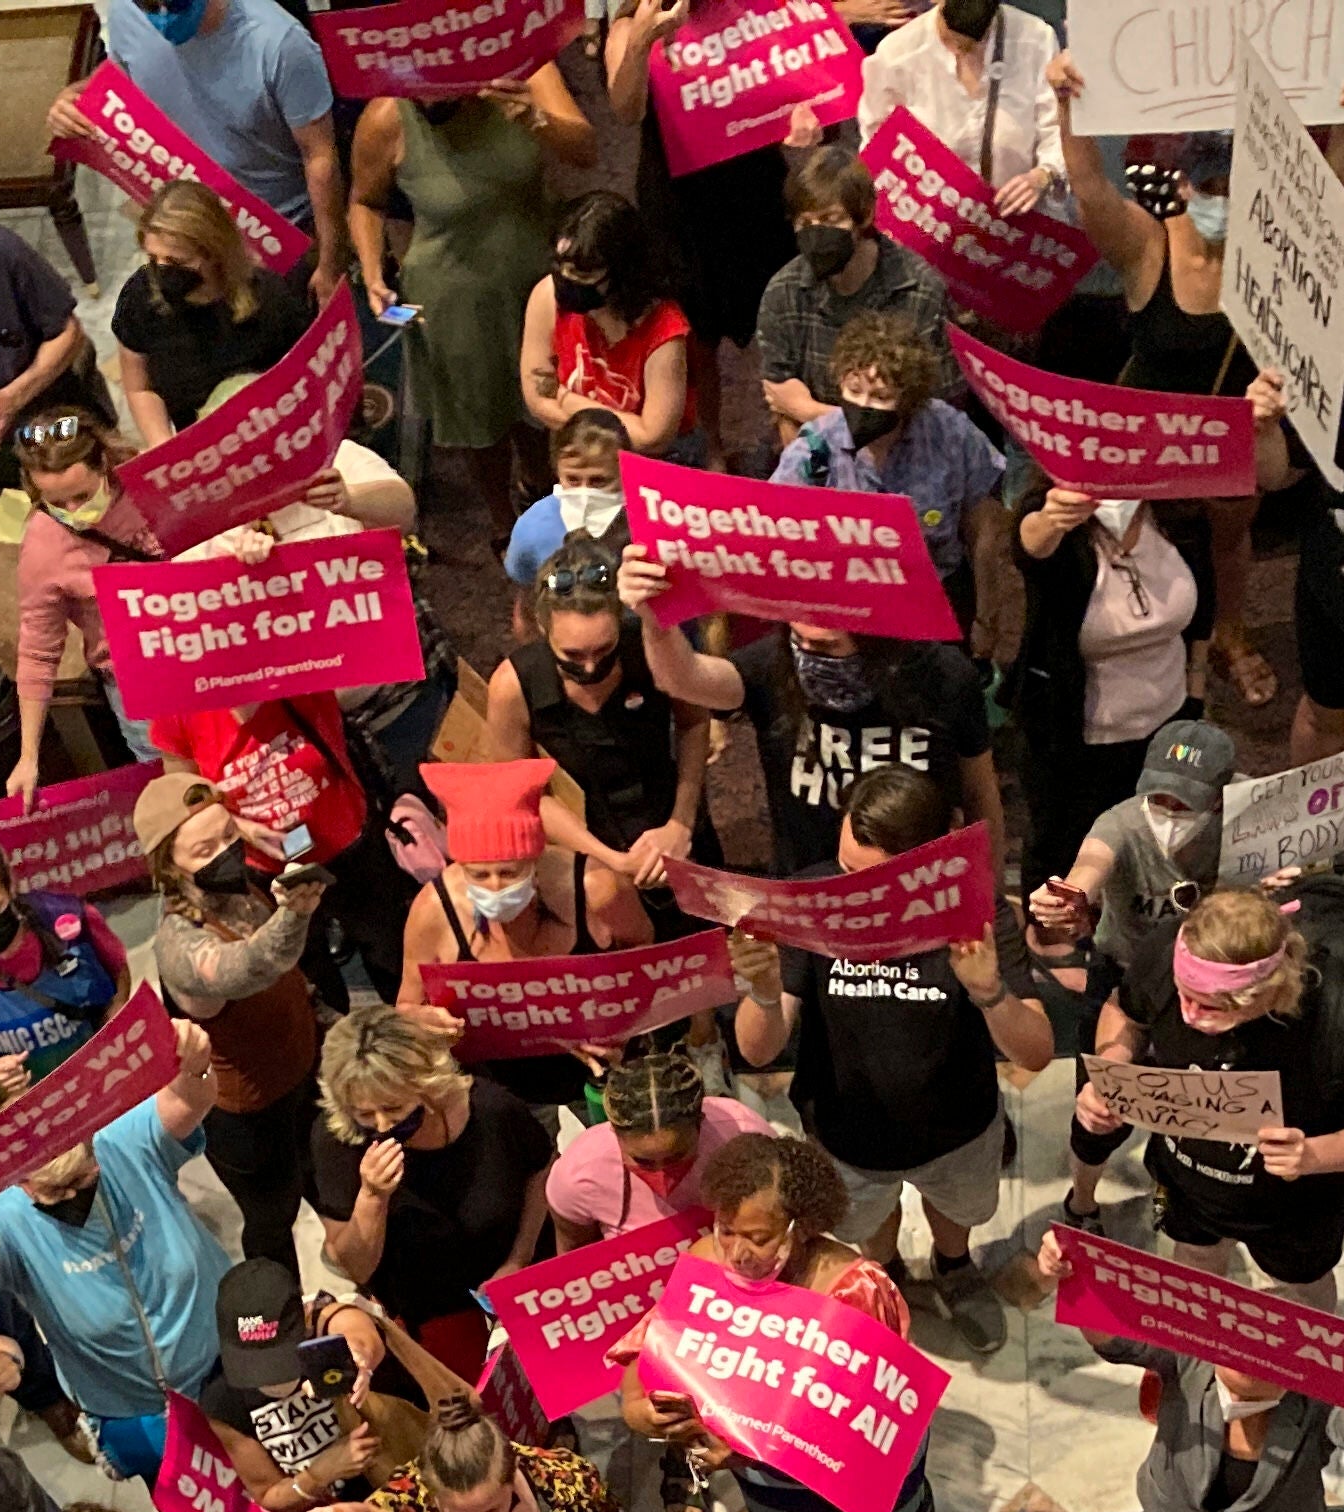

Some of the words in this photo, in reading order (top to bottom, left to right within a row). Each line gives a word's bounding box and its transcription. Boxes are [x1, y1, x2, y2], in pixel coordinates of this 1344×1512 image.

[355, 46, 454, 71] Fight
[460, 28, 515, 59] for
[666, 5, 791, 70] Together
[680, 63, 768, 112] Fight
[769, 42, 813, 75] for
[815, 29, 848, 57] All
[891, 132, 1024, 245] Together
[1030, 232, 1077, 268] We
[236, 206, 281, 255] We
[874, 168, 952, 243] Fight
[952, 234, 1002, 267] for
[1006, 261, 1054, 291] All
[1249, 187, 1332, 328] ABORTION
[1236, 247, 1332, 431] HEALTHCARE
[145, 377, 308, 489] Together
[308, 320, 347, 376] We
[965, 351, 1146, 433] Together
[1155, 412, 1230, 437] We
[169, 456, 271, 511] Fight
[275, 408, 324, 460] for
[1080, 437, 1147, 464] for
[1156, 445, 1219, 465] All
[639, 486, 820, 542] Together
[824, 516, 901, 549] We
[118, 569, 307, 622] Together
[316, 557, 384, 587] We
[656, 539, 766, 579] Fight
[769, 550, 833, 581] for
[846, 557, 907, 586] All
[139, 622, 248, 661] Fight
[253, 609, 316, 640] for
[326, 592, 383, 628] All
[210, 667, 262, 689] Planned
[265, 656, 340, 678] Parenthood
[1251, 775, 1288, 804] GET
[1301, 757, 1344, 787] YOUR
[898, 856, 968, 892] We
[823, 911, 891, 929] for
[901, 885, 960, 922] All
[447, 970, 634, 1001] Together
[641, 950, 708, 979] We
[828, 978, 891, 997] Health
[894, 983, 947, 1001] Care.
[830, 958, 901, 979] Abortion
[905, 962, 919, 980] is
[466, 1001, 574, 1030] Fight
[579, 995, 638, 1021] for
[86, 1019, 147, 1070] We
[33, 1093, 91, 1137] for
[103, 1044, 154, 1094] All
[1089, 1060, 1259, 1100] SCOTUS
[1261, 1099, 1277, 1115] A
[515, 1234, 693, 1317] Together
[1077, 1241, 1287, 1325] Together
[541, 1294, 644, 1351] Fight
[1094, 1265, 1207, 1321] Fight
[1217, 1312, 1286, 1348] for
[689, 1283, 871, 1378] Together
[875, 1357, 920, 1417] We
[676, 1328, 785, 1388] Fight
[791, 1365, 852, 1419] for
[849, 1405, 899, 1457] All
[269, 1413, 339, 1458] WITH
[772, 1422, 843, 1473] Parenthood
[191, 1445, 237, 1489] All
